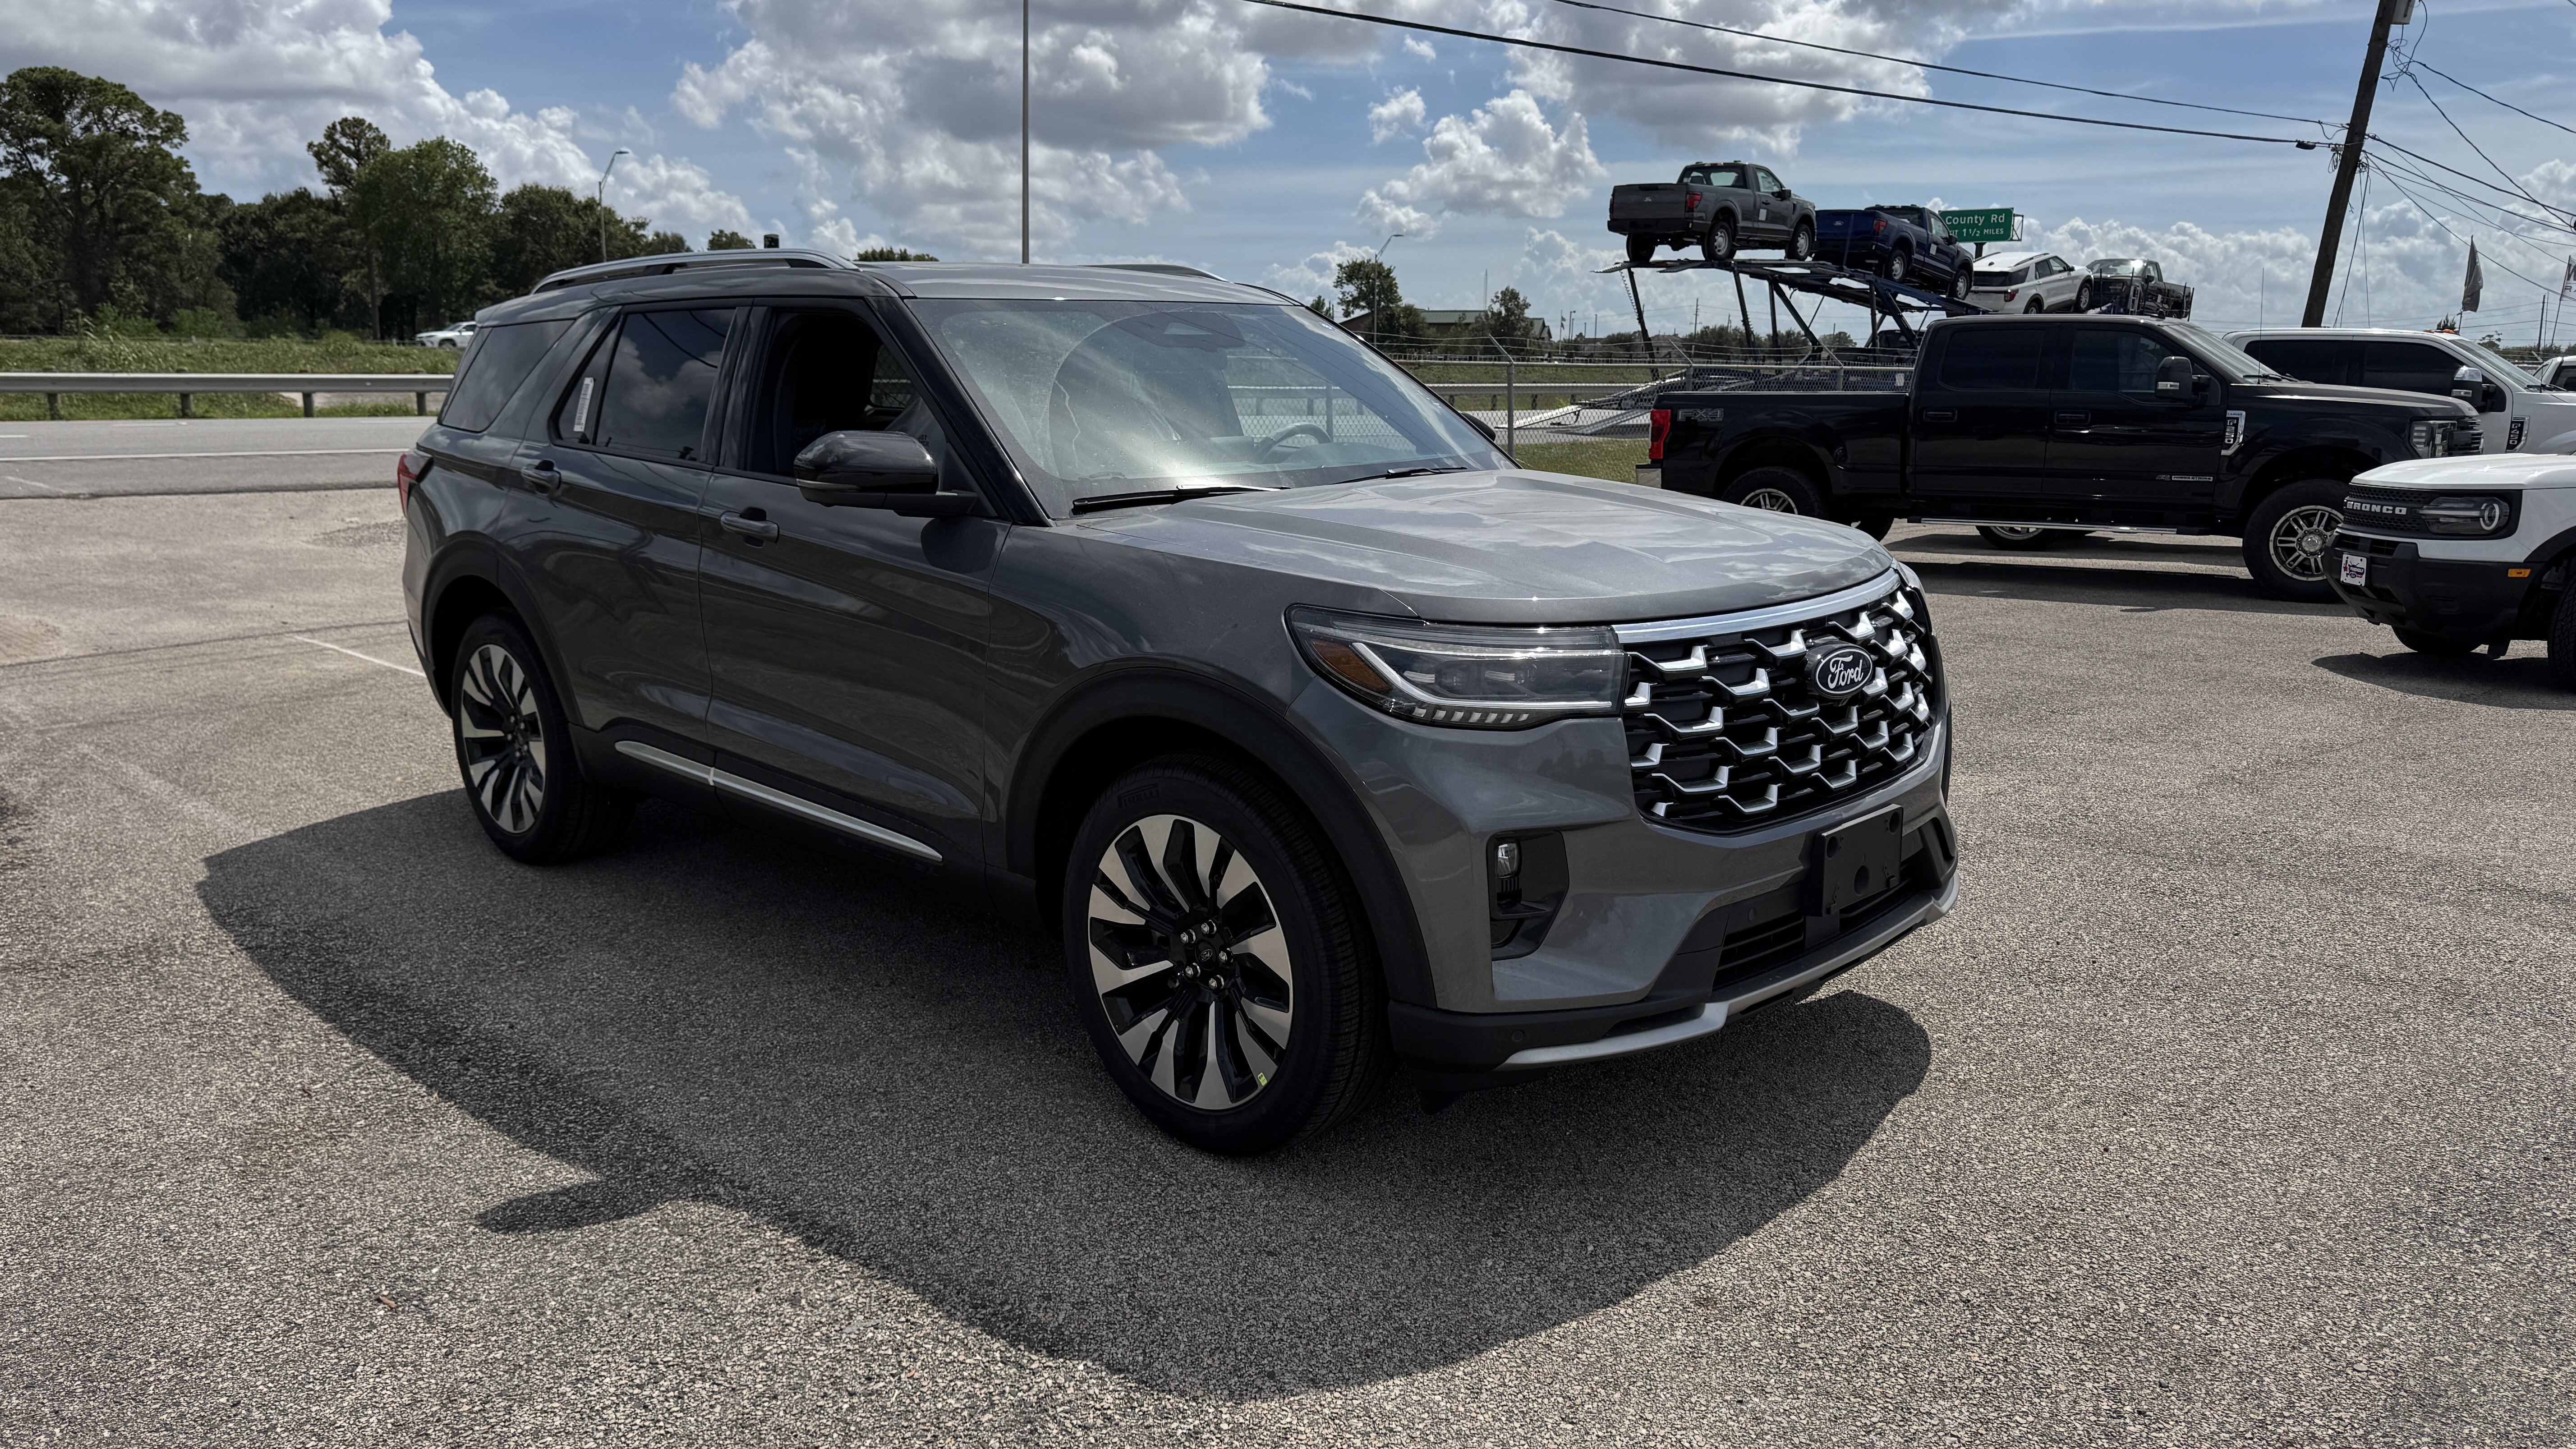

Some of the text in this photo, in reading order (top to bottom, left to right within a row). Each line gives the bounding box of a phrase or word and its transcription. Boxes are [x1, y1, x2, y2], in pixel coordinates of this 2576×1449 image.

[1946, 213, 2005, 226] County Rd
[1677, 408, 1724, 421] FX4
[2346, 501, 2407, 515] BRONCO
[1828, 655, 1863, 689] Ford
[1118, 783, 1159, 809] PIRELLI
